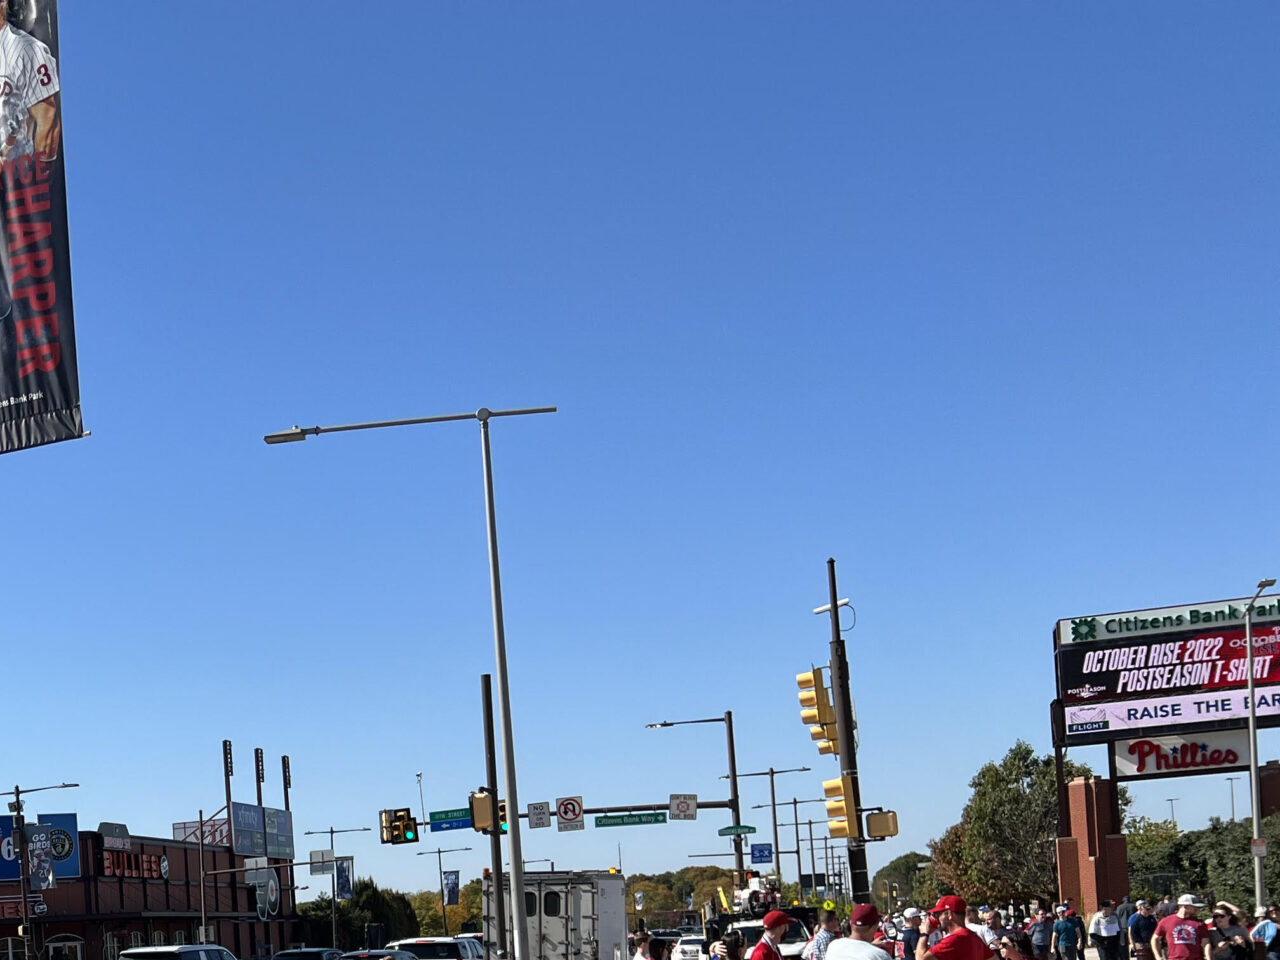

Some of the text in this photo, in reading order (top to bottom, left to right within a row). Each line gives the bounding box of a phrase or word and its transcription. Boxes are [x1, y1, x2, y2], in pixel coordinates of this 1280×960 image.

[5, 183, 61, 379] HARPER
[10, 393, 27, 405] Bank
[28, 390, 43, 401] Park
[1105, 612, 1183, 634] Citizens
[1189, 605, 1238, 624] Bank
[1082, 637, 1223, 674] OCTOBER RISE 2022
[1117, 655, 1274, 693] POSTSEASON T-SHRT
[1127, 704, 1182, 721] RAISE
[1194, 699, 1232, 714] THE
[1073, 722, 1104, 731] FLIGHT
[1128, 739, 1239, 773] Phillies
[448, 809, 466, 818] STREET
[597, 814, 655, 825] Citizens Bank Way
[29, 840, 51, 850] BIRDS
[32, 833, 46, 842] GO
[103, 850, 161, 878] BULLIES
